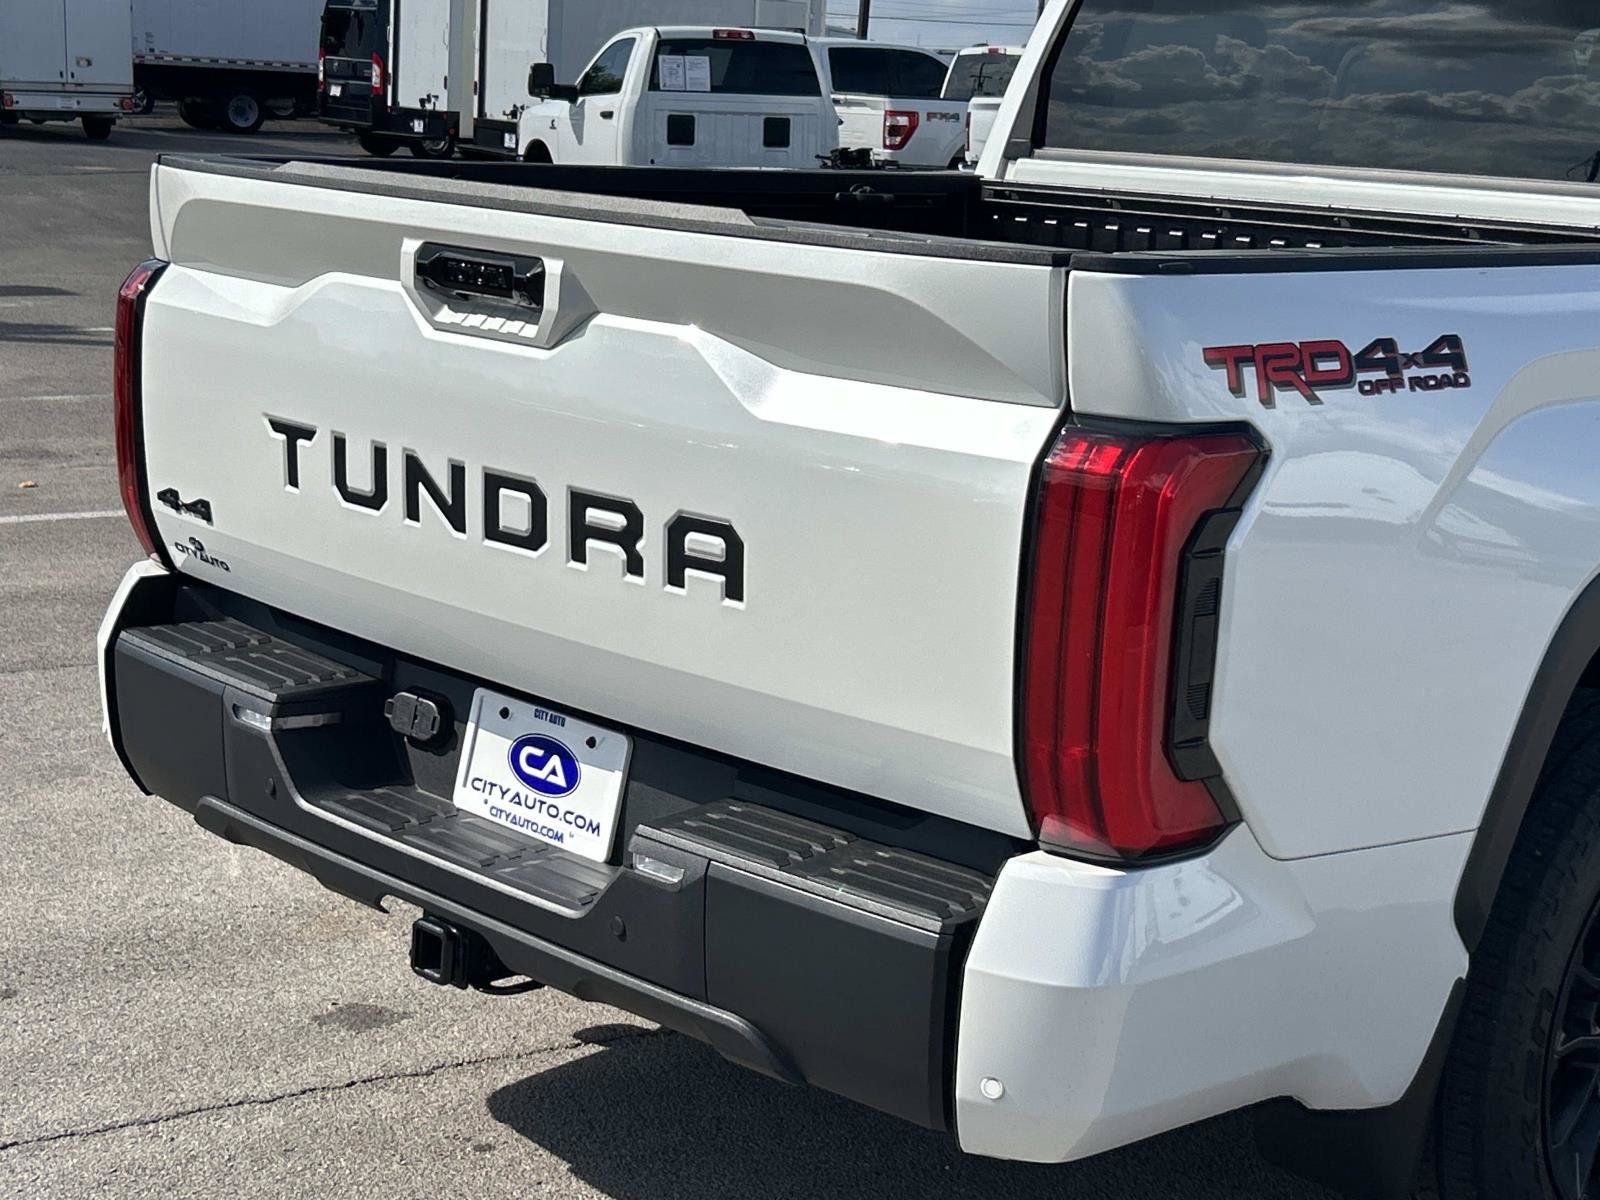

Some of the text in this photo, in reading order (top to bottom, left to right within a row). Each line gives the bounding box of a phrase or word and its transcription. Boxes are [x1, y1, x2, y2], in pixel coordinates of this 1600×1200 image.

[1203, 339, 1356, 409] TRD
[1357, 373, 1471, 396] OFF ROAD
[263, 413, 747, 609] TUNDRA
[533, 708, 566, 728] CITY AUTO
[518, 745, 568, 789] CA
[471, 777, 601, 837] CITYAUTO.COM
[489, 805, 564, 844] CITYAUTO.COM
